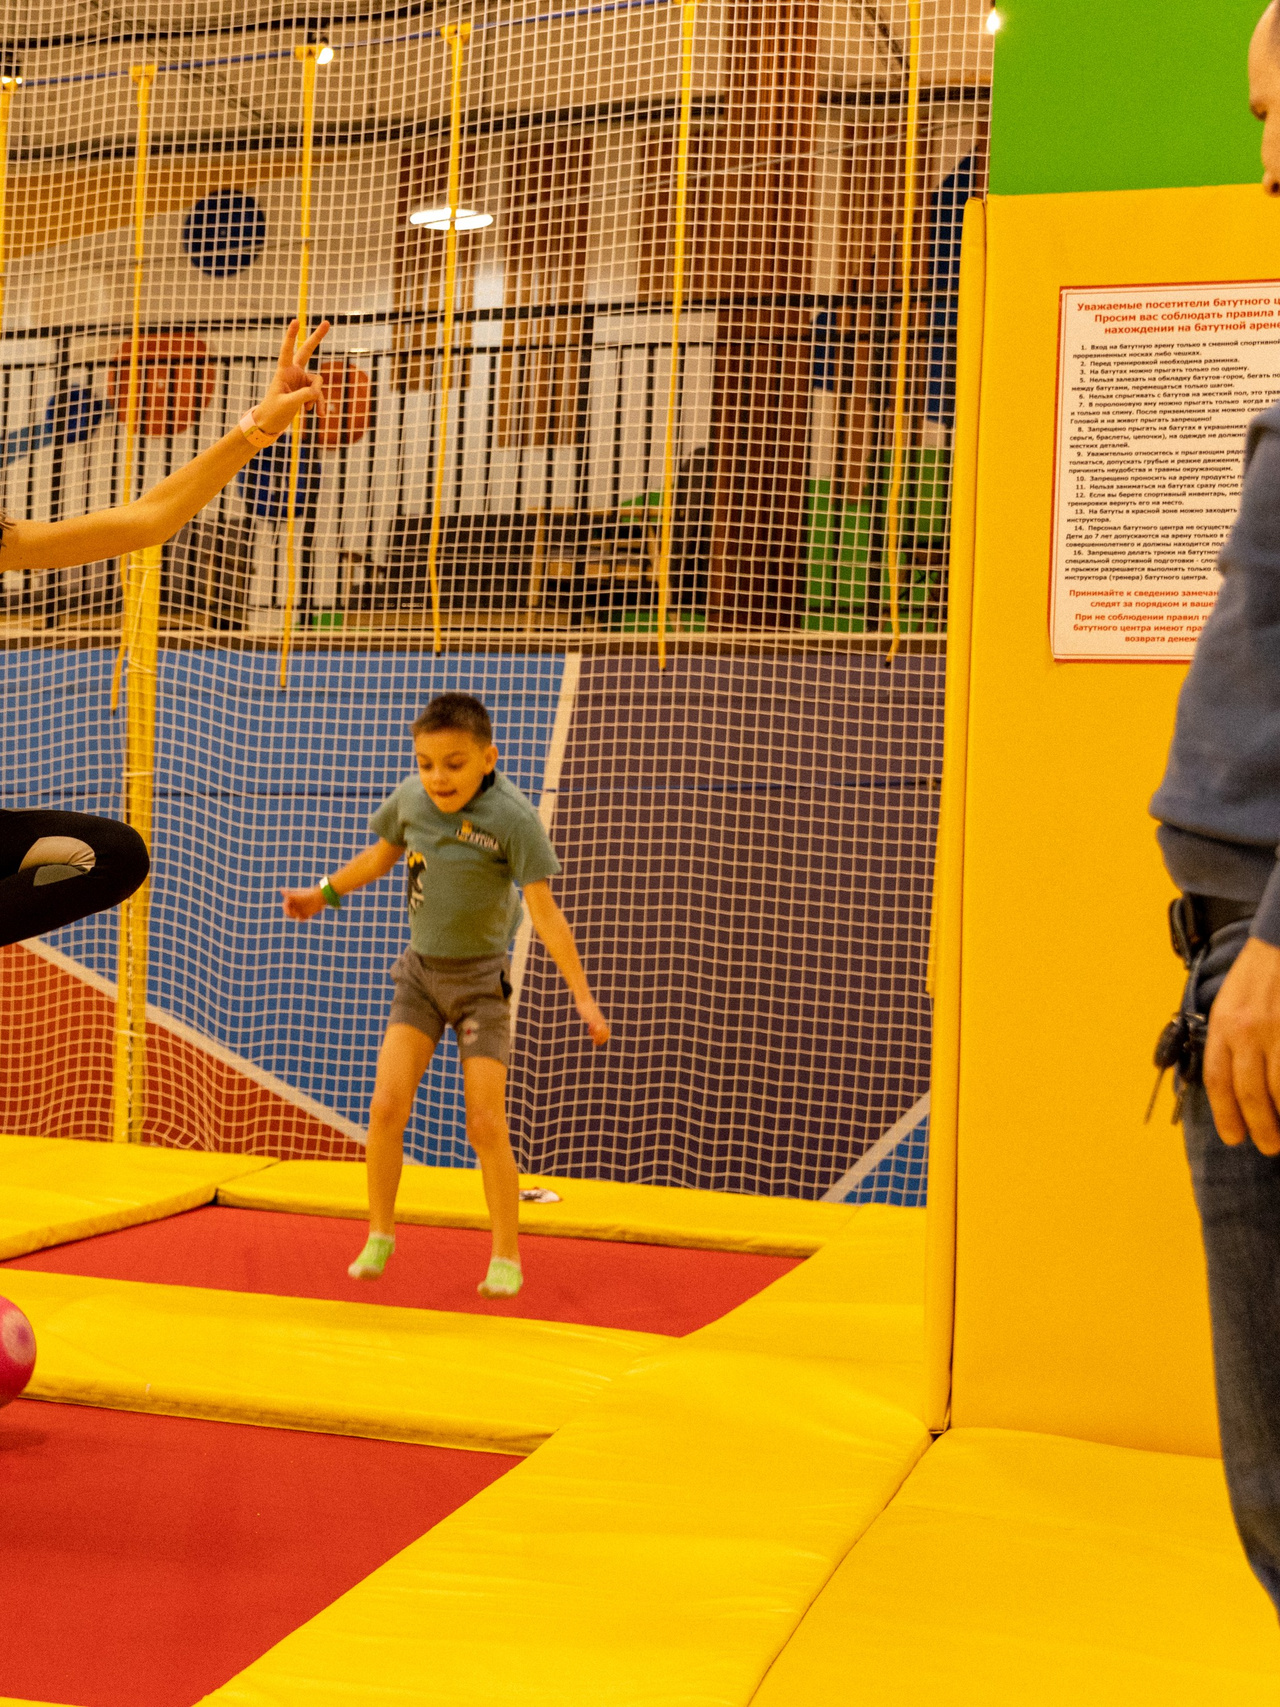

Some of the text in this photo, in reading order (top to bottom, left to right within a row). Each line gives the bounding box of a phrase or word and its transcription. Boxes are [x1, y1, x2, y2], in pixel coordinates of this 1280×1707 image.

[1077, 302, 1142, 311] Уважаемые
[1213, 298, 1270, 307] батутного
[1094, 314, 1136, 323] Просим
[1160, 311, 1222, 320] соблюдать
[1226, 310, 1274, 319] правила
[1104, 326, 1174, 334] нахождении
[1194, 321, 1246, 332] батутной
[1075, 613, 1092, 621] При
[1073, 624, 1118, 632] батутного
